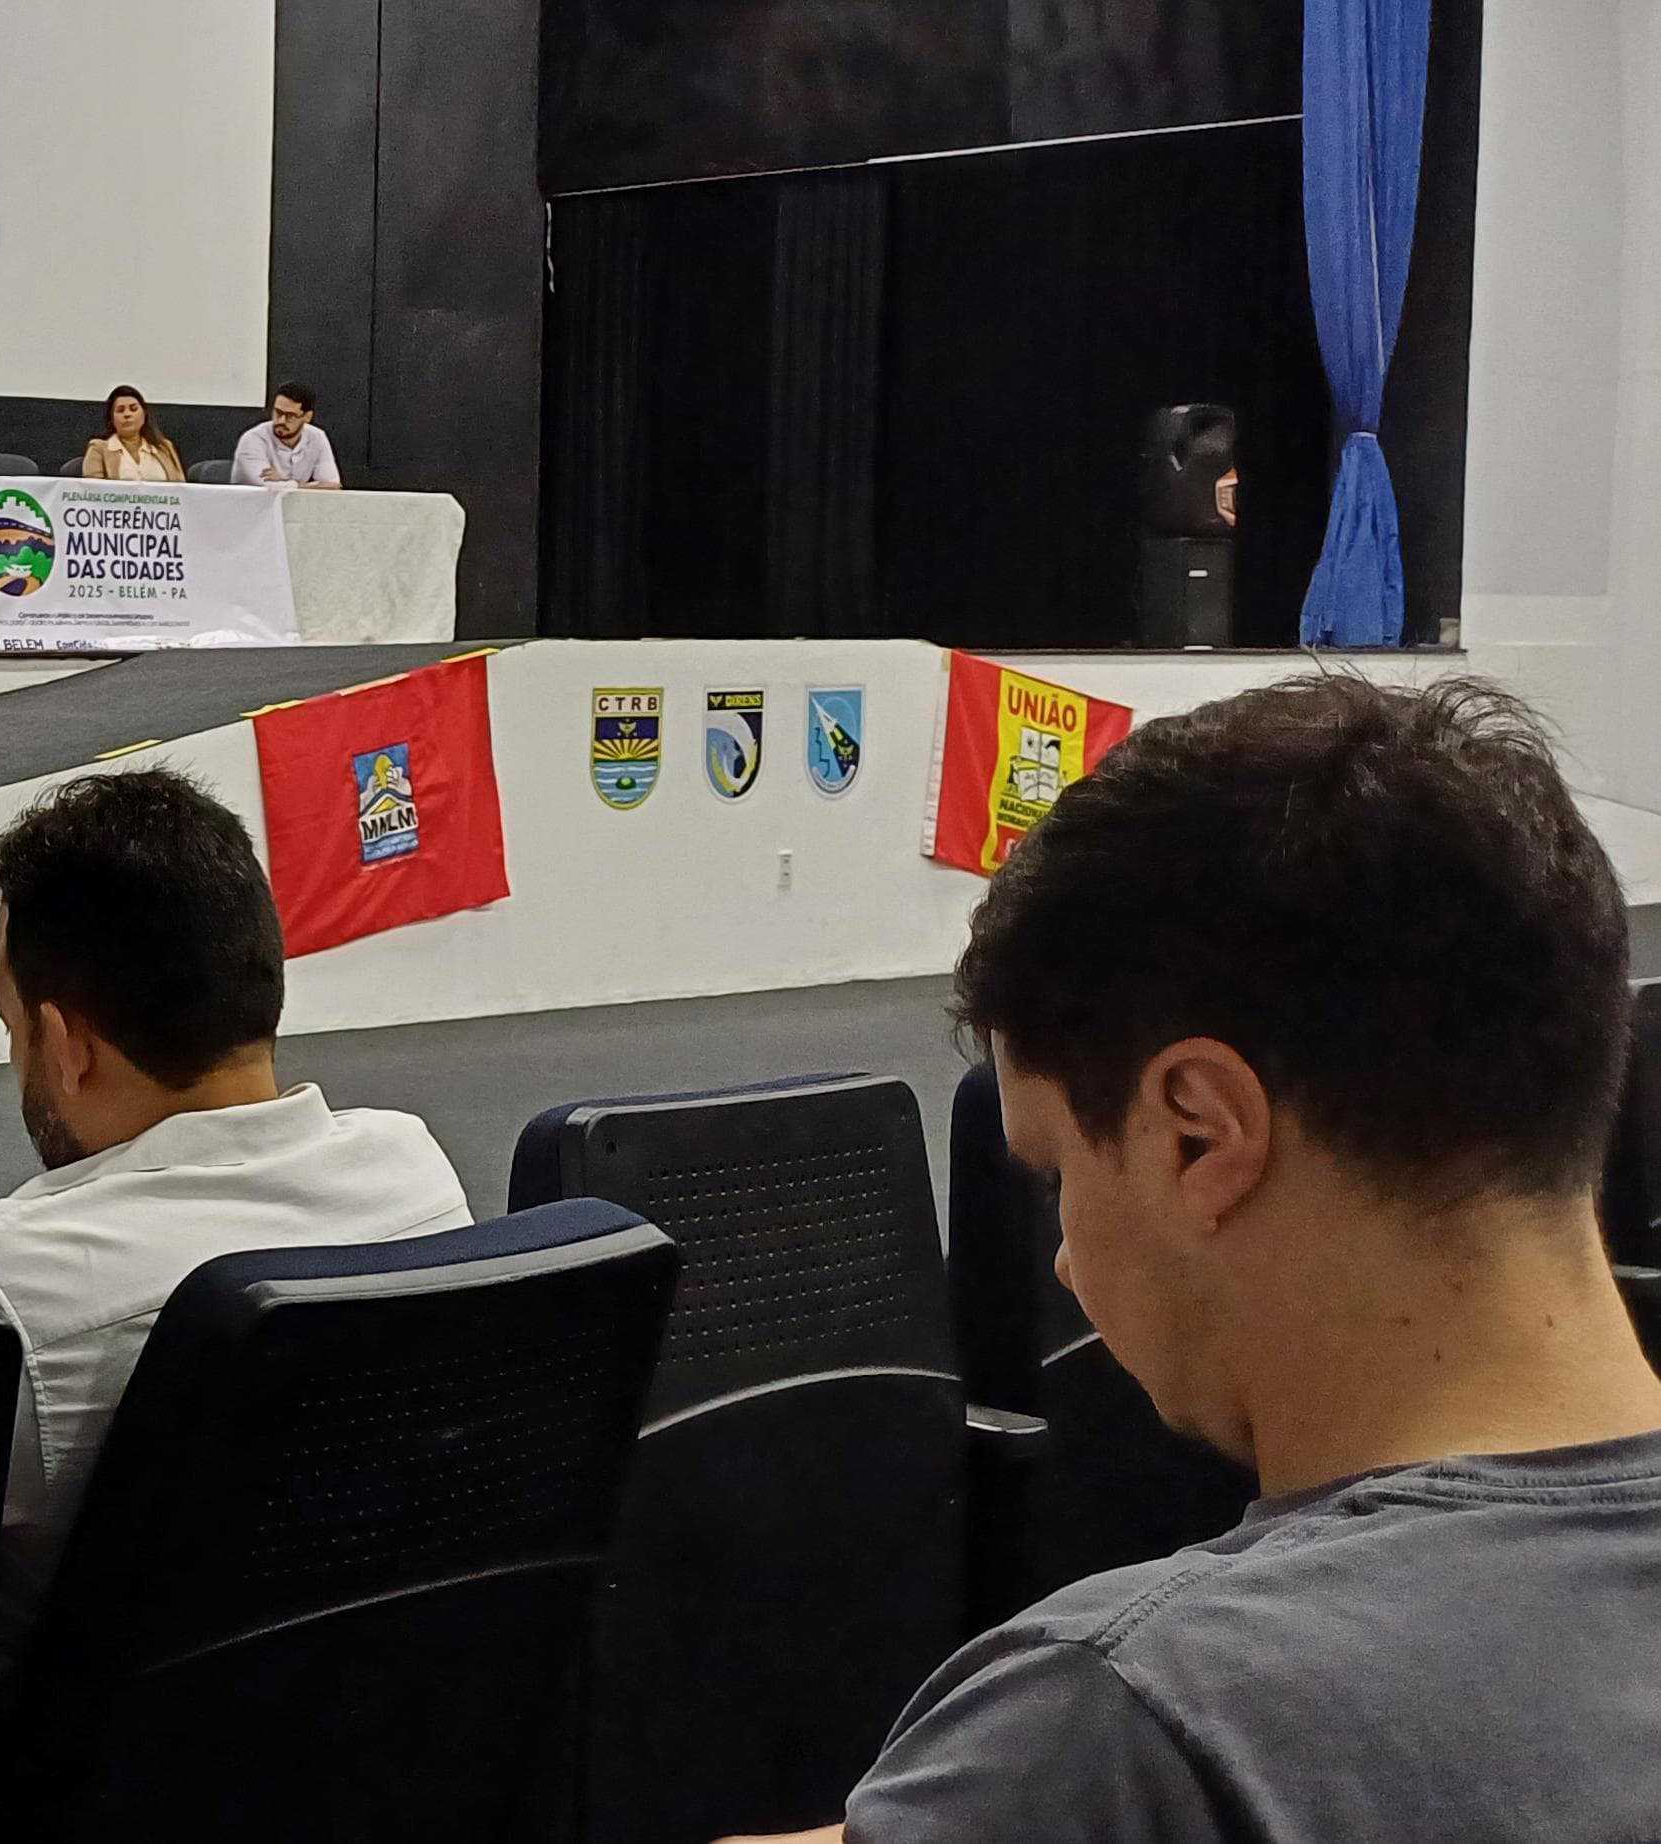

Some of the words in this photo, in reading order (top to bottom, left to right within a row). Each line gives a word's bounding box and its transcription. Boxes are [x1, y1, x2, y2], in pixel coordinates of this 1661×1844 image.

[63, 506, 181, 531] CONFERÊNCIA
[66, 532, 182, 558] MUNICIPAL
[67, 559, 106, 579] DAS
[110, 560, 184, 581] CIDADES
[68, 585, 103, 598] 2025
[119, 584, 157, 598] BELÉM
[171, 587, 187, 599] PA
[1008, 685, 1077, 732] UNIÃO
